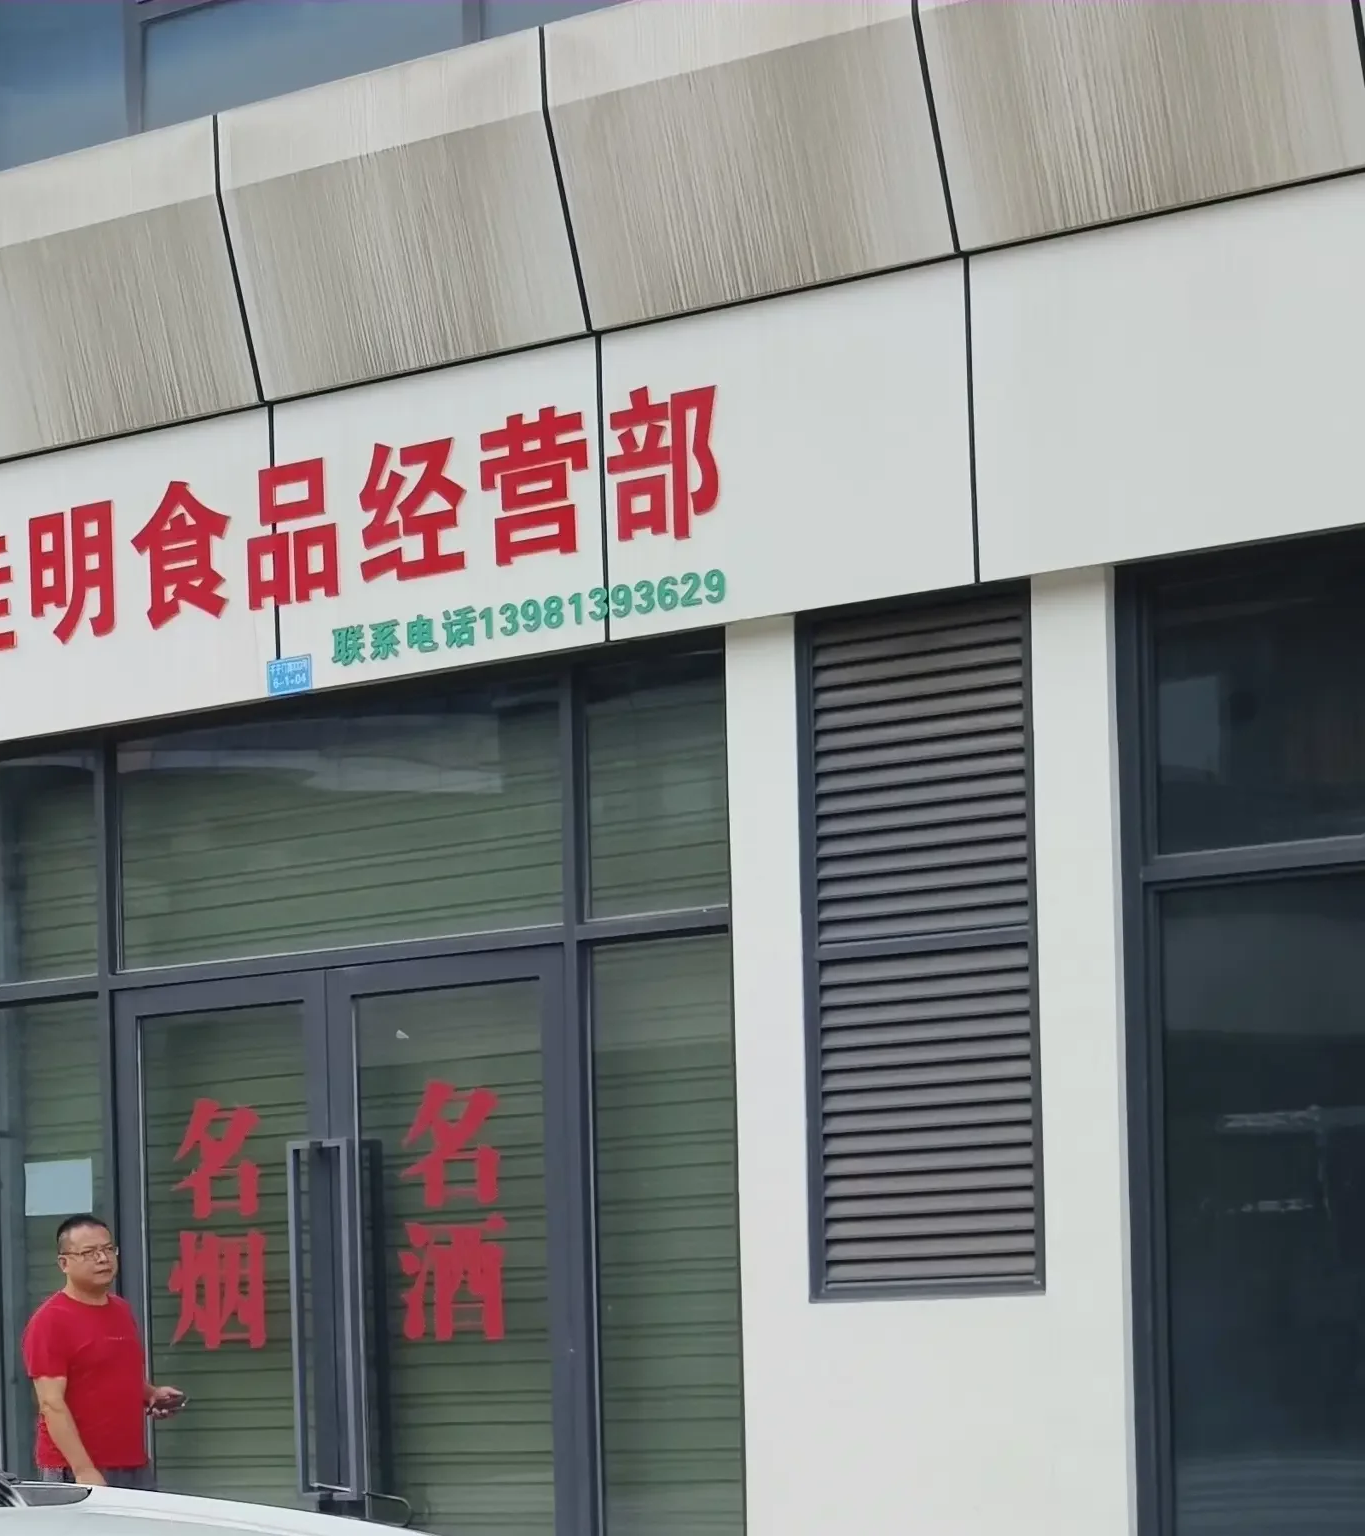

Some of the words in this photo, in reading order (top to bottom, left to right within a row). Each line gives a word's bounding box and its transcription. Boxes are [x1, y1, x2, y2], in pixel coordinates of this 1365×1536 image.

[331, 568, 728, 666] 联系电话13981393629
[168, 1098, 266, 1348] 名烟
[399, 1082, 507, 1340] 名酒
